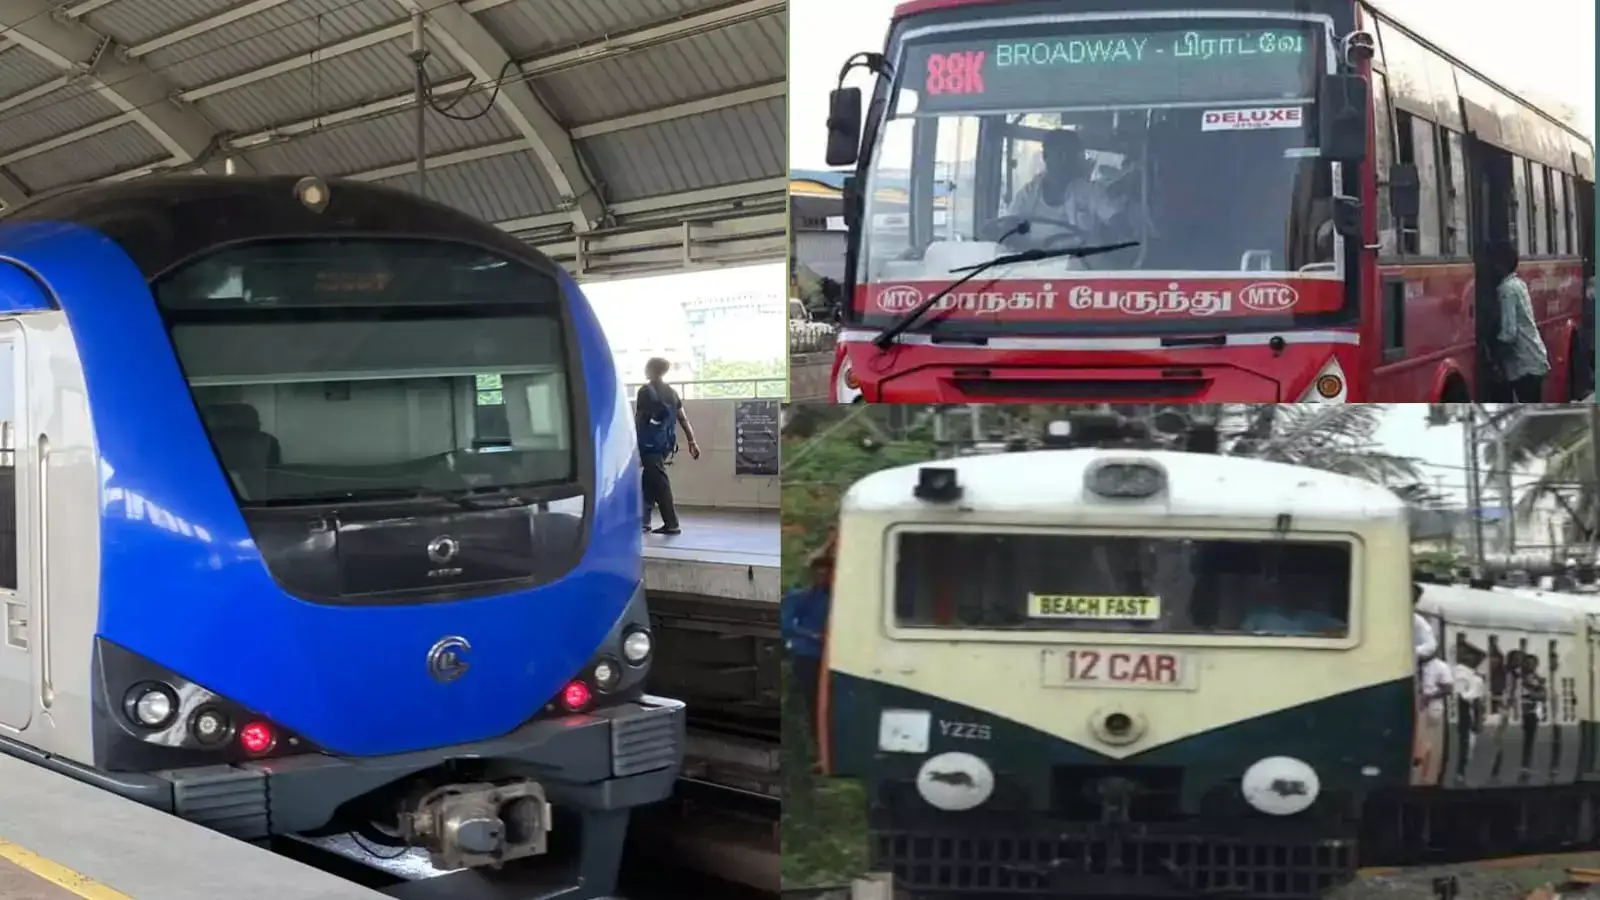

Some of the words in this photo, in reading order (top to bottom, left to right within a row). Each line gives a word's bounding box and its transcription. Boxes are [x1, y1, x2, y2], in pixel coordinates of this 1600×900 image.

[996, 37, 1148, 67] BROADWAY
[926, 51, 986, 95] 88K
[1206, 109, 1300, 124] DELUXE
[883, 292, 916, 307] MTC
[1068, 282, 1232, 316] பேருந்து
[1249, 286, 1290, 305] MTC
[1040, 597, 1101, 616] BEACH
[1105, 598, 1151, 617] FAST
[1066, 650, 1101, 680] 12
[1109, 653, 1178, 683] CAR
